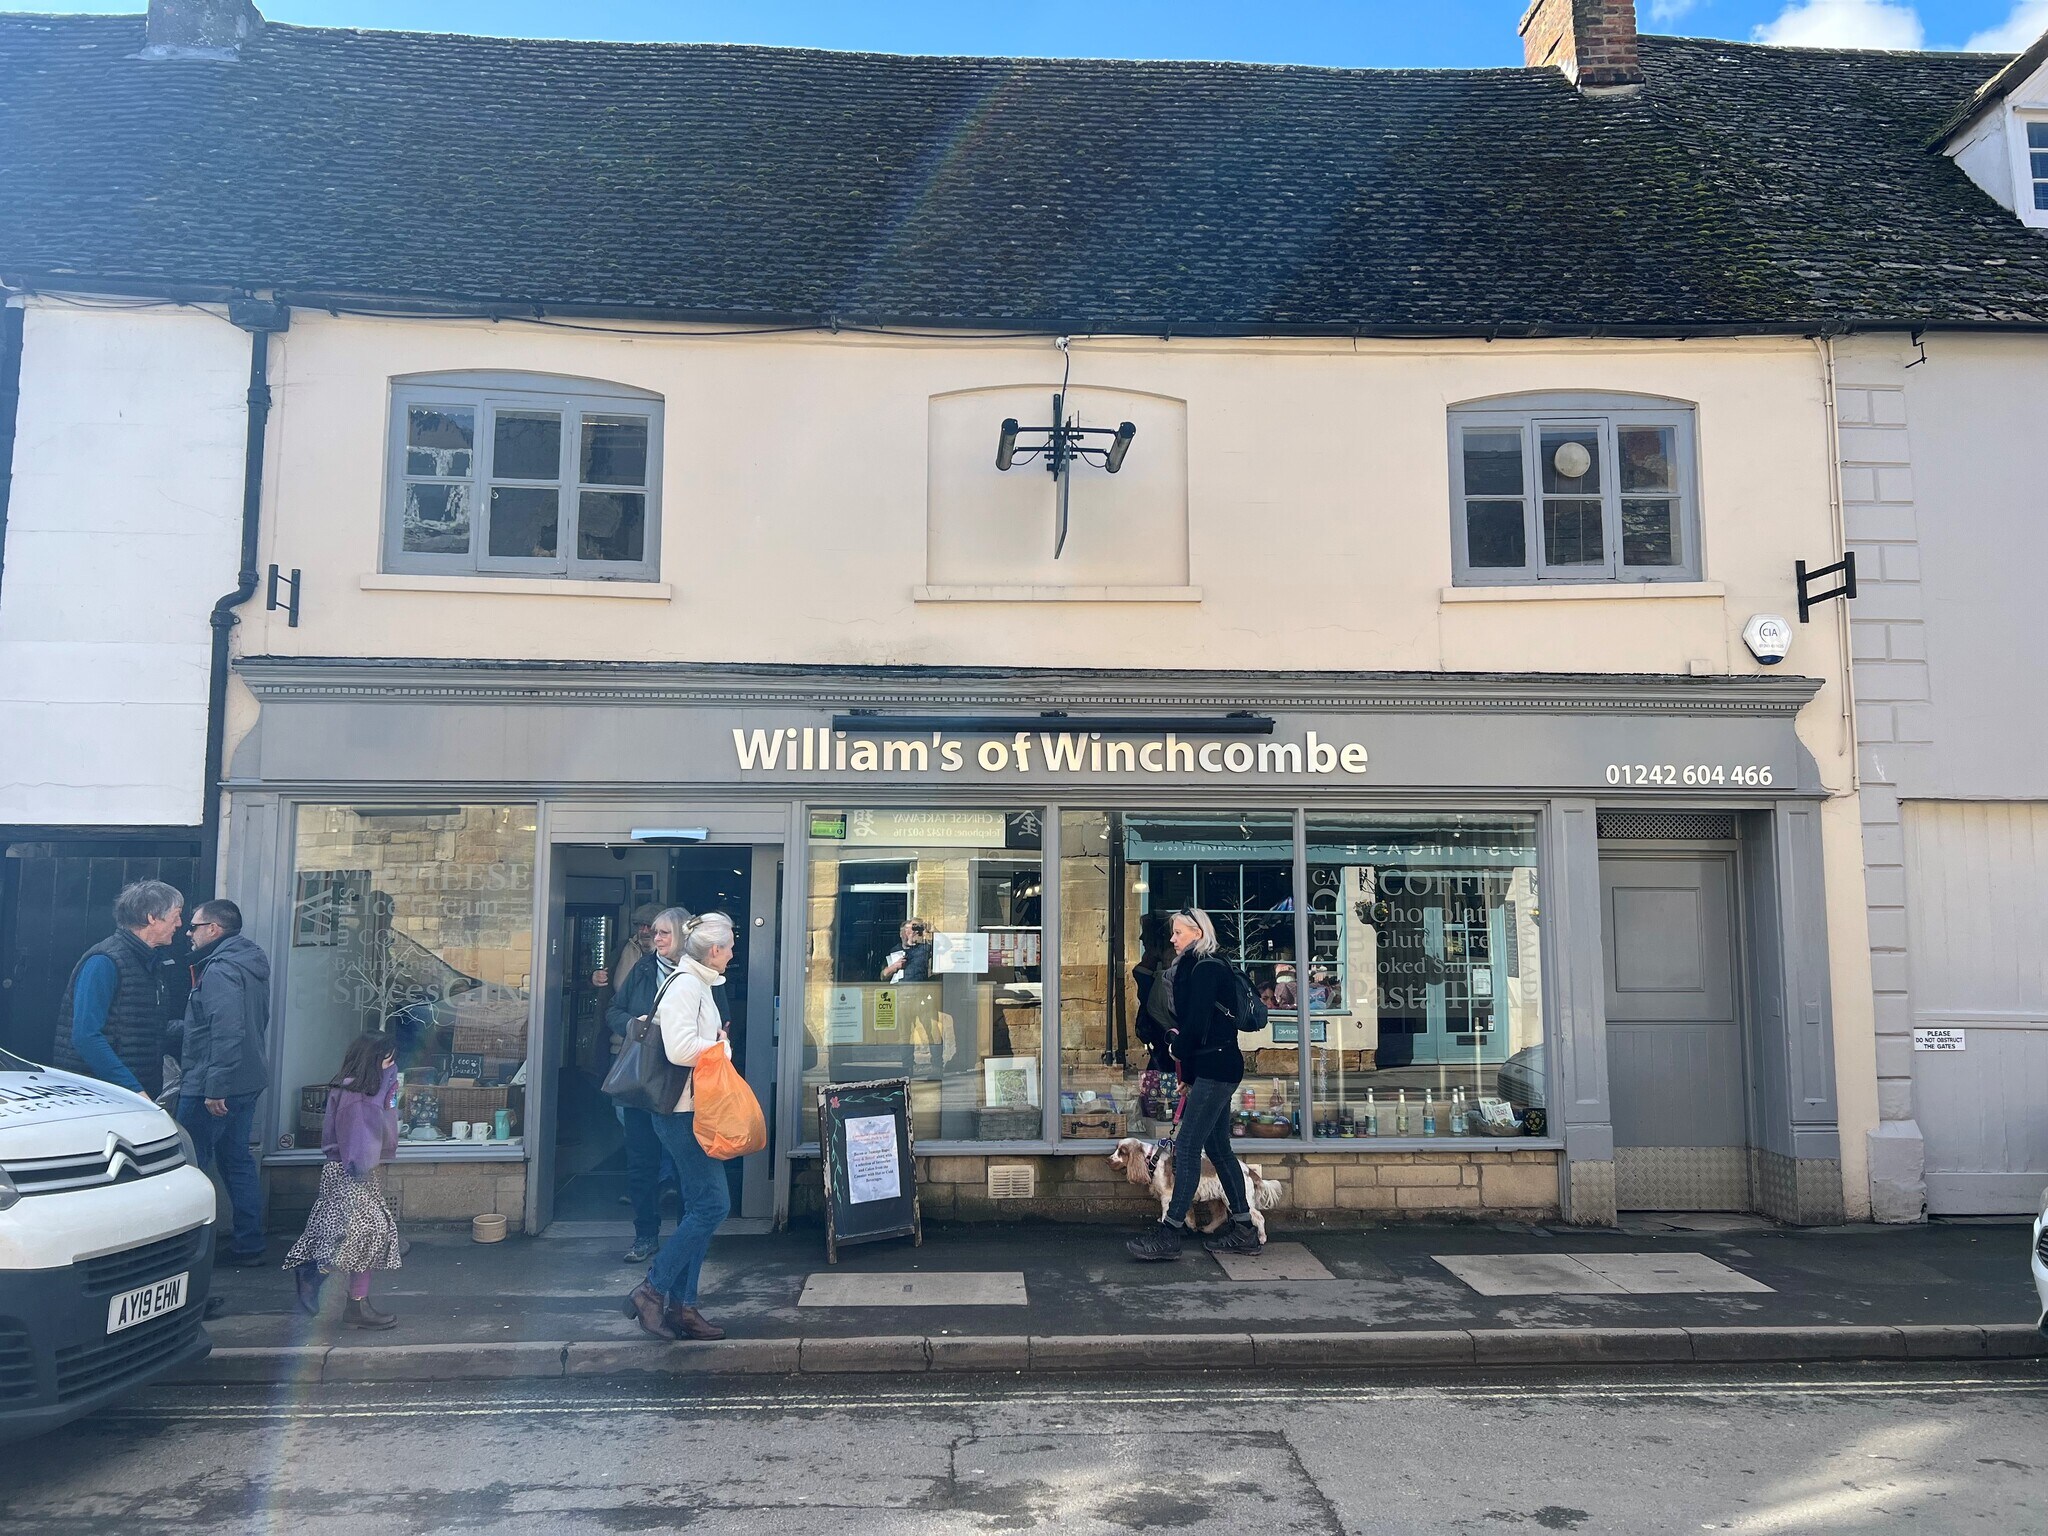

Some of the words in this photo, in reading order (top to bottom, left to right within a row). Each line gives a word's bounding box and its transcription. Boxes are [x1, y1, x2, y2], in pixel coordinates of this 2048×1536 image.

[1762, 628, 1778, 637] CIA
[732, 728, 963, 773] William's
[978, 730, 1033, 773] of
[1046, 730, 1368, 774] Winchcombe
[1605, 764, 1677, 785] 01242
[1683, 764, 1725, 786] 604
[1730, 765, 1773, 786] 466
[386, 862, 531, 892] HEESE
[361, 895, 396, 917] Ice
[1369, 901, 1490, 923] Chocolat
[1457, 930, 1491, 949] Fre
[1519, 868, 1539, 1004] MARMALAD
[1348, 979, 1438, 1010] Pasta
[118, 1288, 153, 1326] AY19
[154, 1279, 181, 1313] EHN
